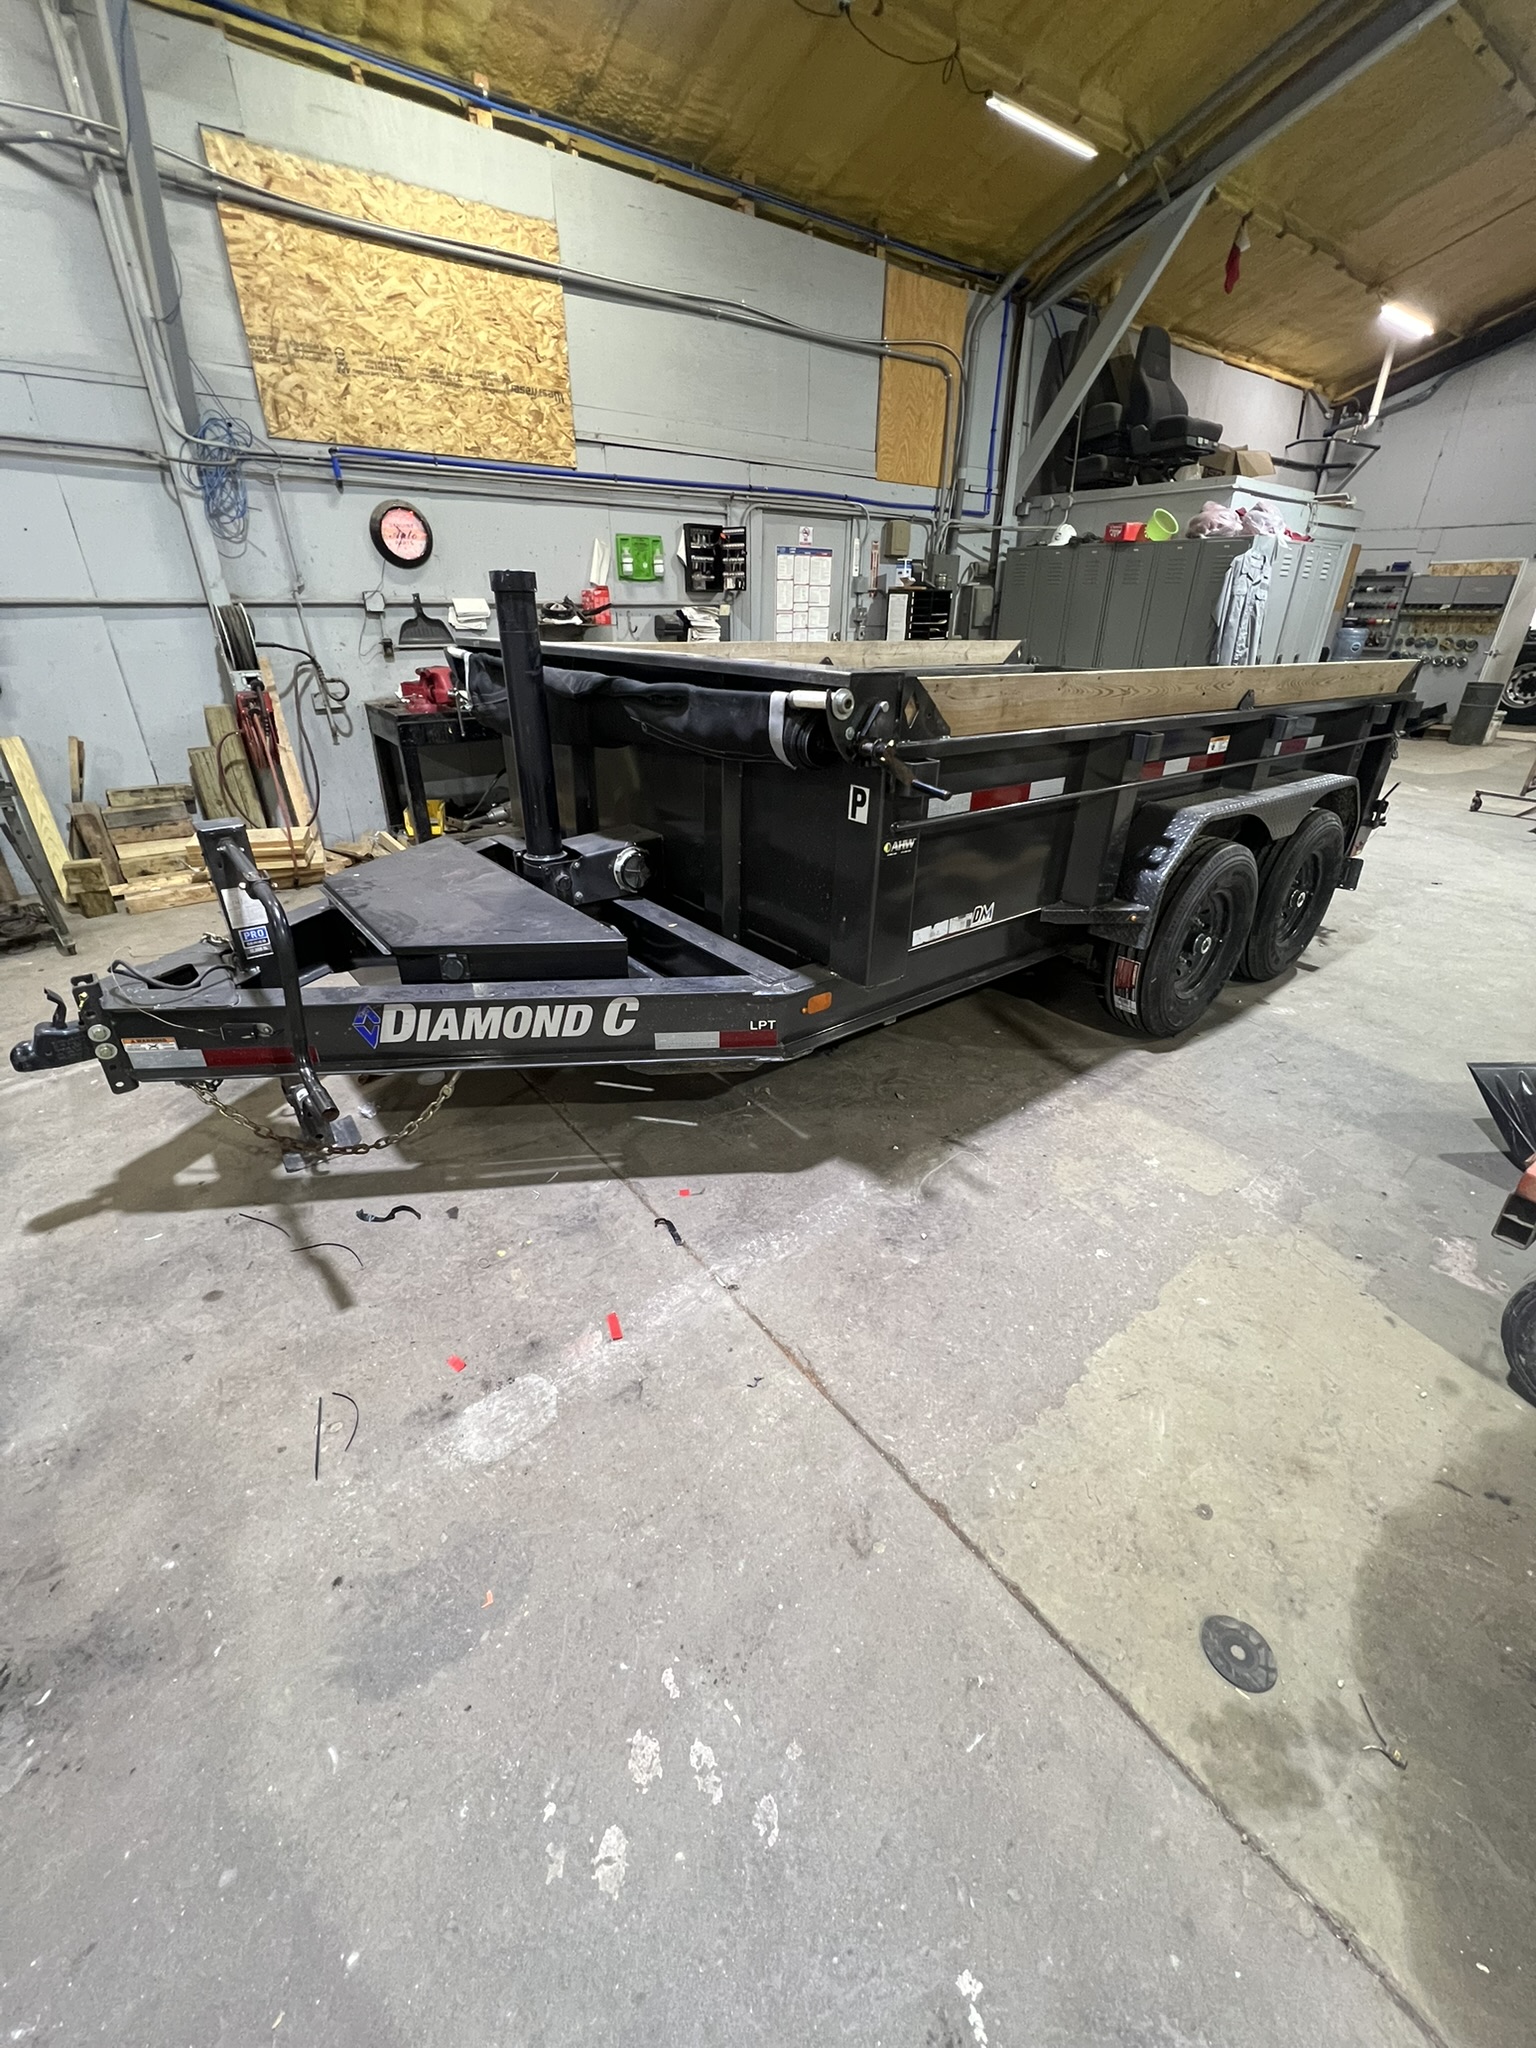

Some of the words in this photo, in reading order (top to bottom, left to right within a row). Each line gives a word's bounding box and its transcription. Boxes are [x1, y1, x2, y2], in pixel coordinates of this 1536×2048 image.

[851, 787, 867, 820] P
[891, 838, 917, 852] AHW
[972, 902, 995, 924] DM
[243, 929, 265, 940] PRO
[379, 1003, 594, 1043] DIAMOND
[602, 996, 640, 1037] C
[749, 1020, 777, 1031] LPT
